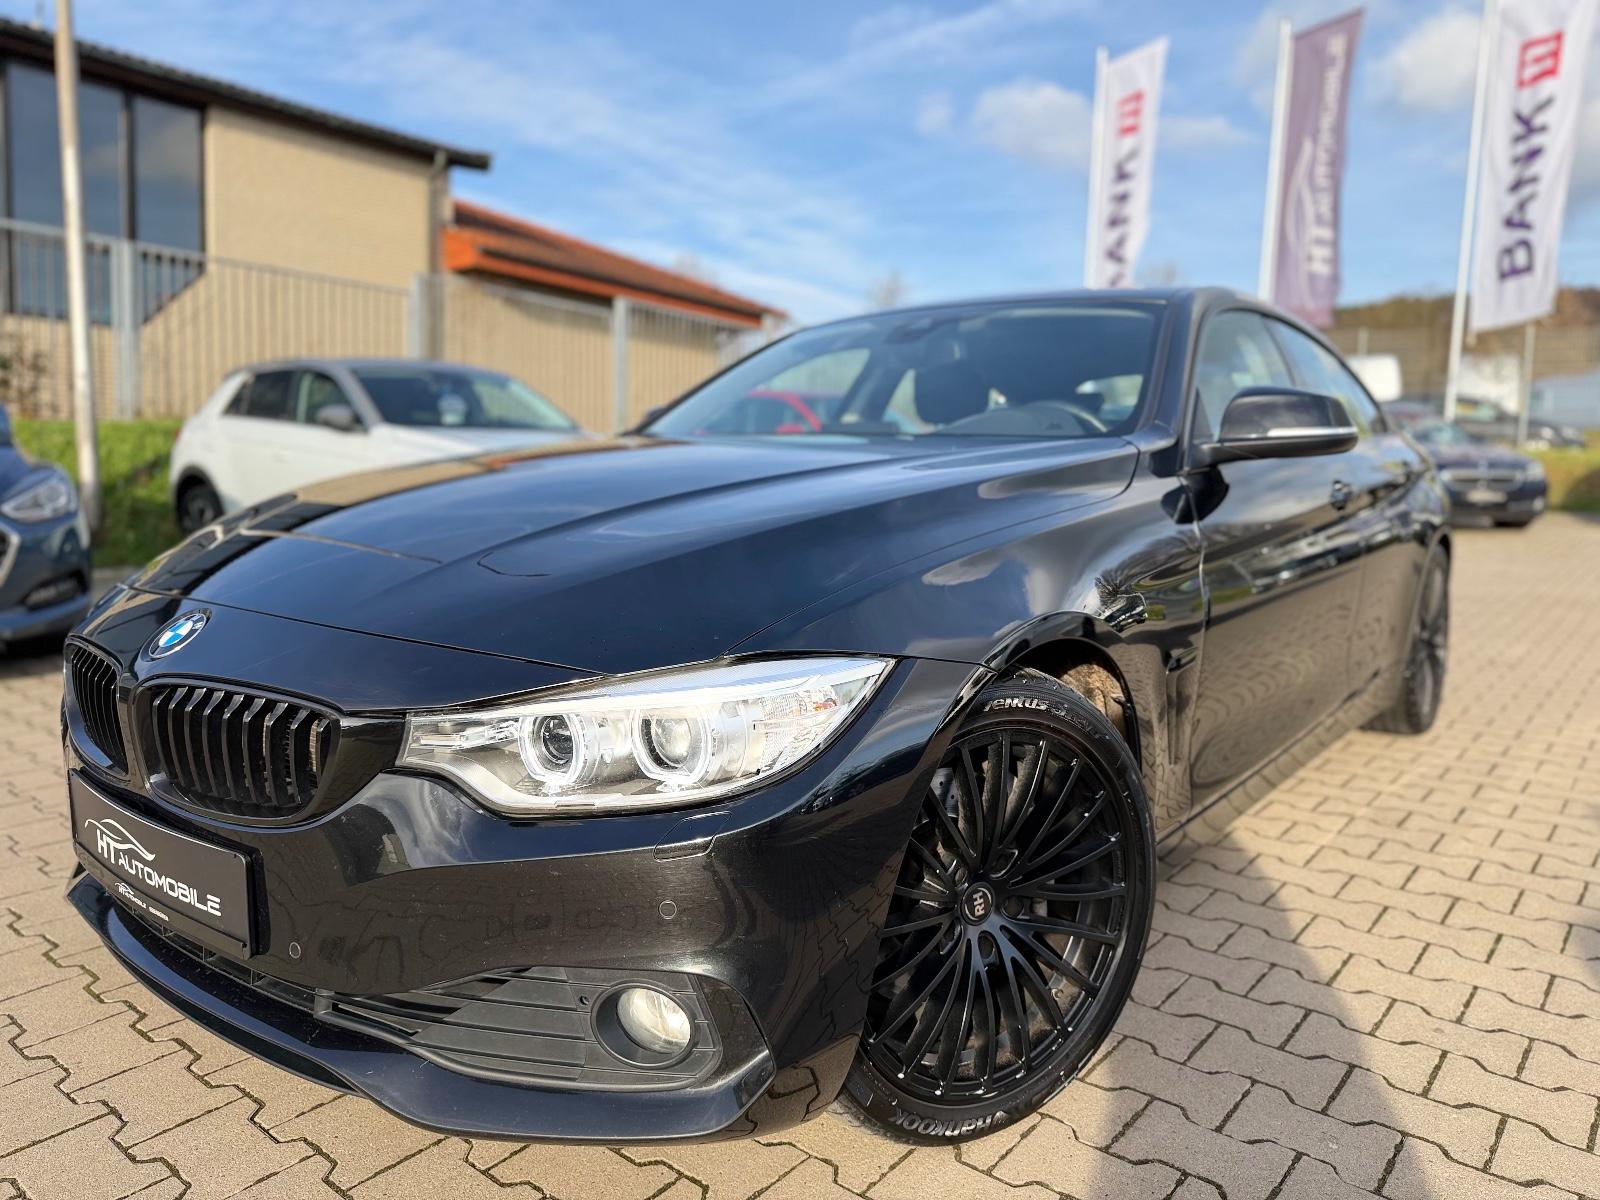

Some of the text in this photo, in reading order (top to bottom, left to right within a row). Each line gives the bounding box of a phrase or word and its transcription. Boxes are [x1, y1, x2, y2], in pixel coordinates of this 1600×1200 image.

[1499, 95, 1555, 280] BANK
[97, 828, 221, 917] HT AUTOMOBILE
[973, 891, 985, 917] RH
